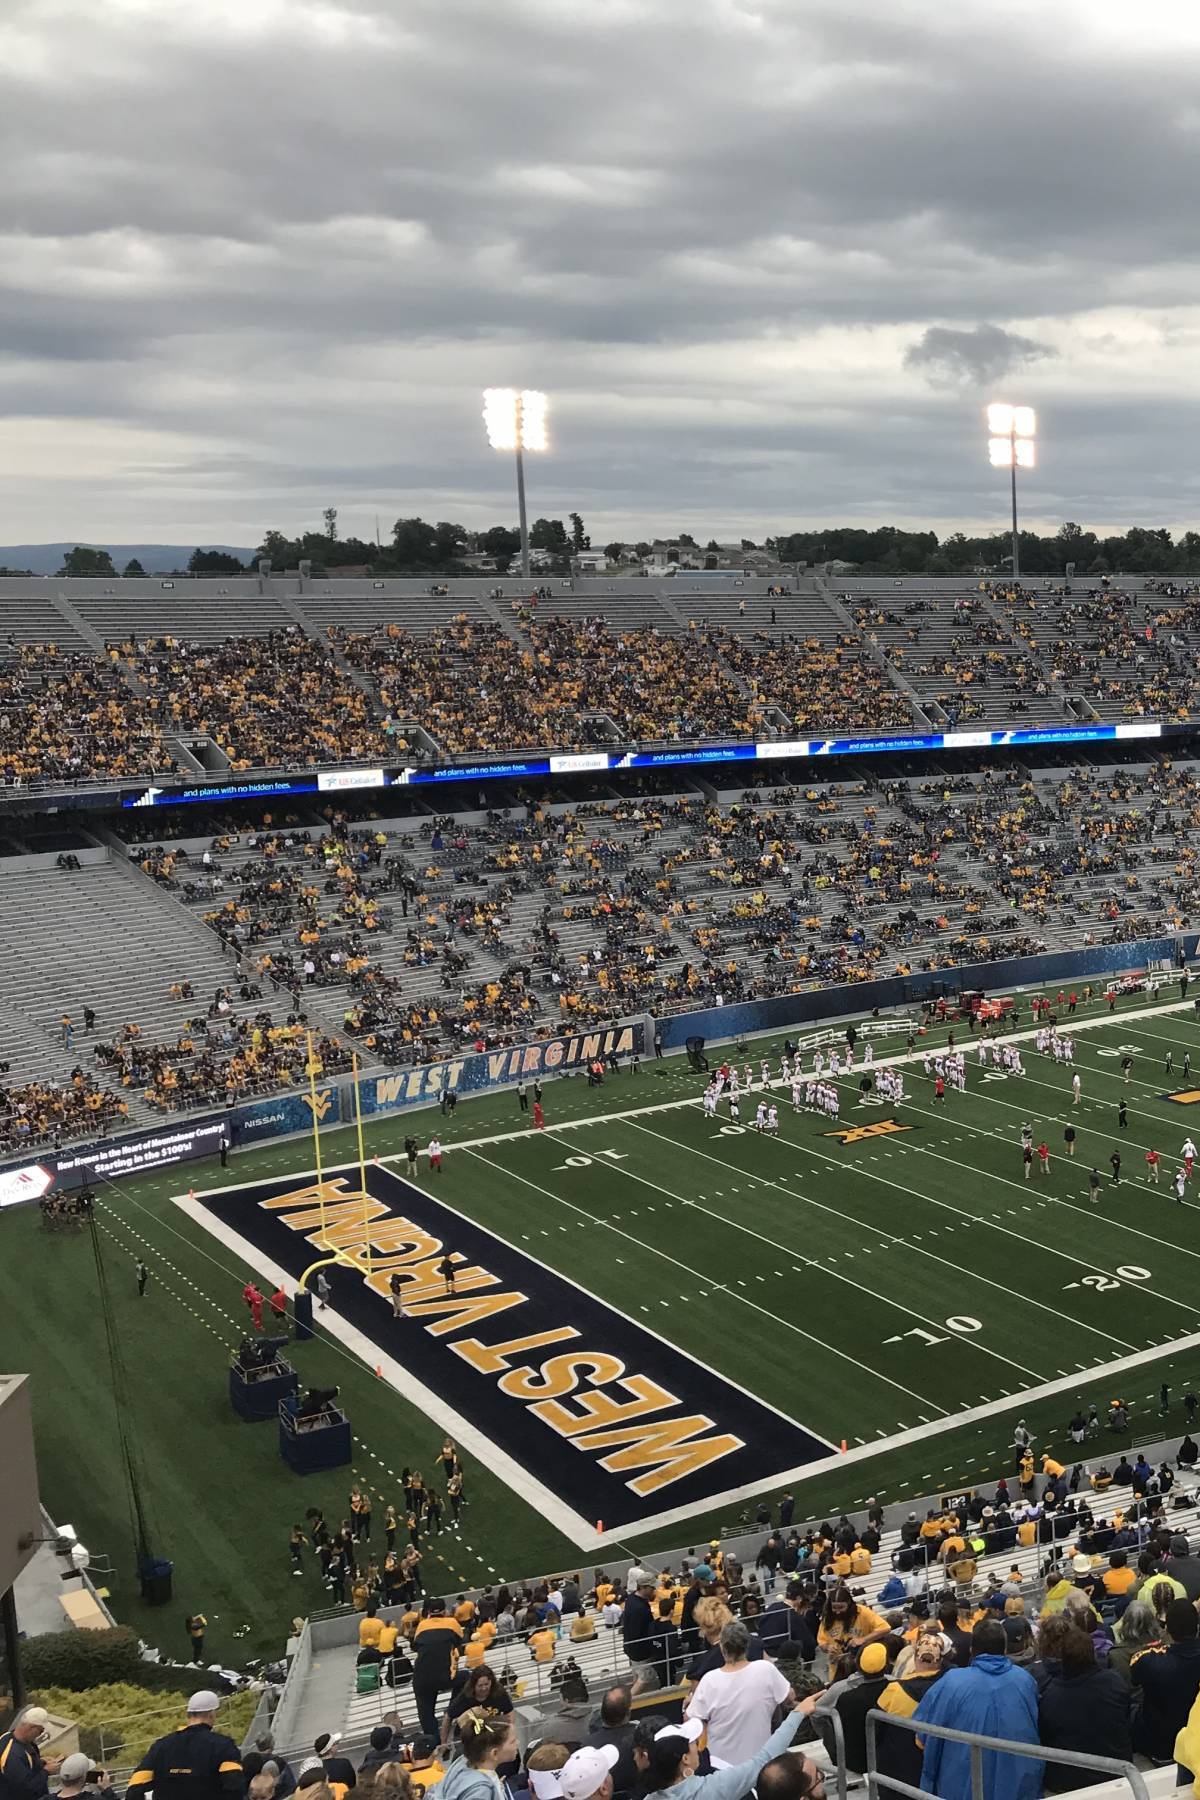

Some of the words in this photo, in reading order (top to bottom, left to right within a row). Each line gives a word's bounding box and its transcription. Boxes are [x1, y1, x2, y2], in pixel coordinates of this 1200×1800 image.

[434, 769, 446, 777] and
[447, 768, 465, 777] plans
[465, 766, 479, 774] with
[489, 764, 511, 773] hidden
[183, 788, 198, 797] and
[199, 787, 220, 797] plans
[220, 785, 237, 795] with
[249, 782, 273, 792] hidden
[376, 1063, 466, 1104] WEST
[487, 1027, 633, 1081] VIRGINIA
[244, 1112, 285, 1129] NISSAN
[57, 1160, 74, 1171] New
[74, 1155, 99, 1168] Homes
[99, 1153, 107, 1163] in
[108, 1150, 121, 1162] the
[121, 1145, 142, 1159] Heart
[142, 1143, 151, 1155] of
[151, 1131, 195, 1152] Mountaineer
[195, 1123, 225, 1138] Country!
[94, 1159, 133, 1174] Starting
[134, 1154, 144, 1165] in
[144, 1150, 160, 1162] the
[161, 1142, 192, 1157] $100's!
[257, 1177, 531, 1337] VIRGINIA
[1080, 1265, 1152, 1292] 20
[903, 1315, 984, 1347] 10
[444, 1325, 747, 1498] WEST
